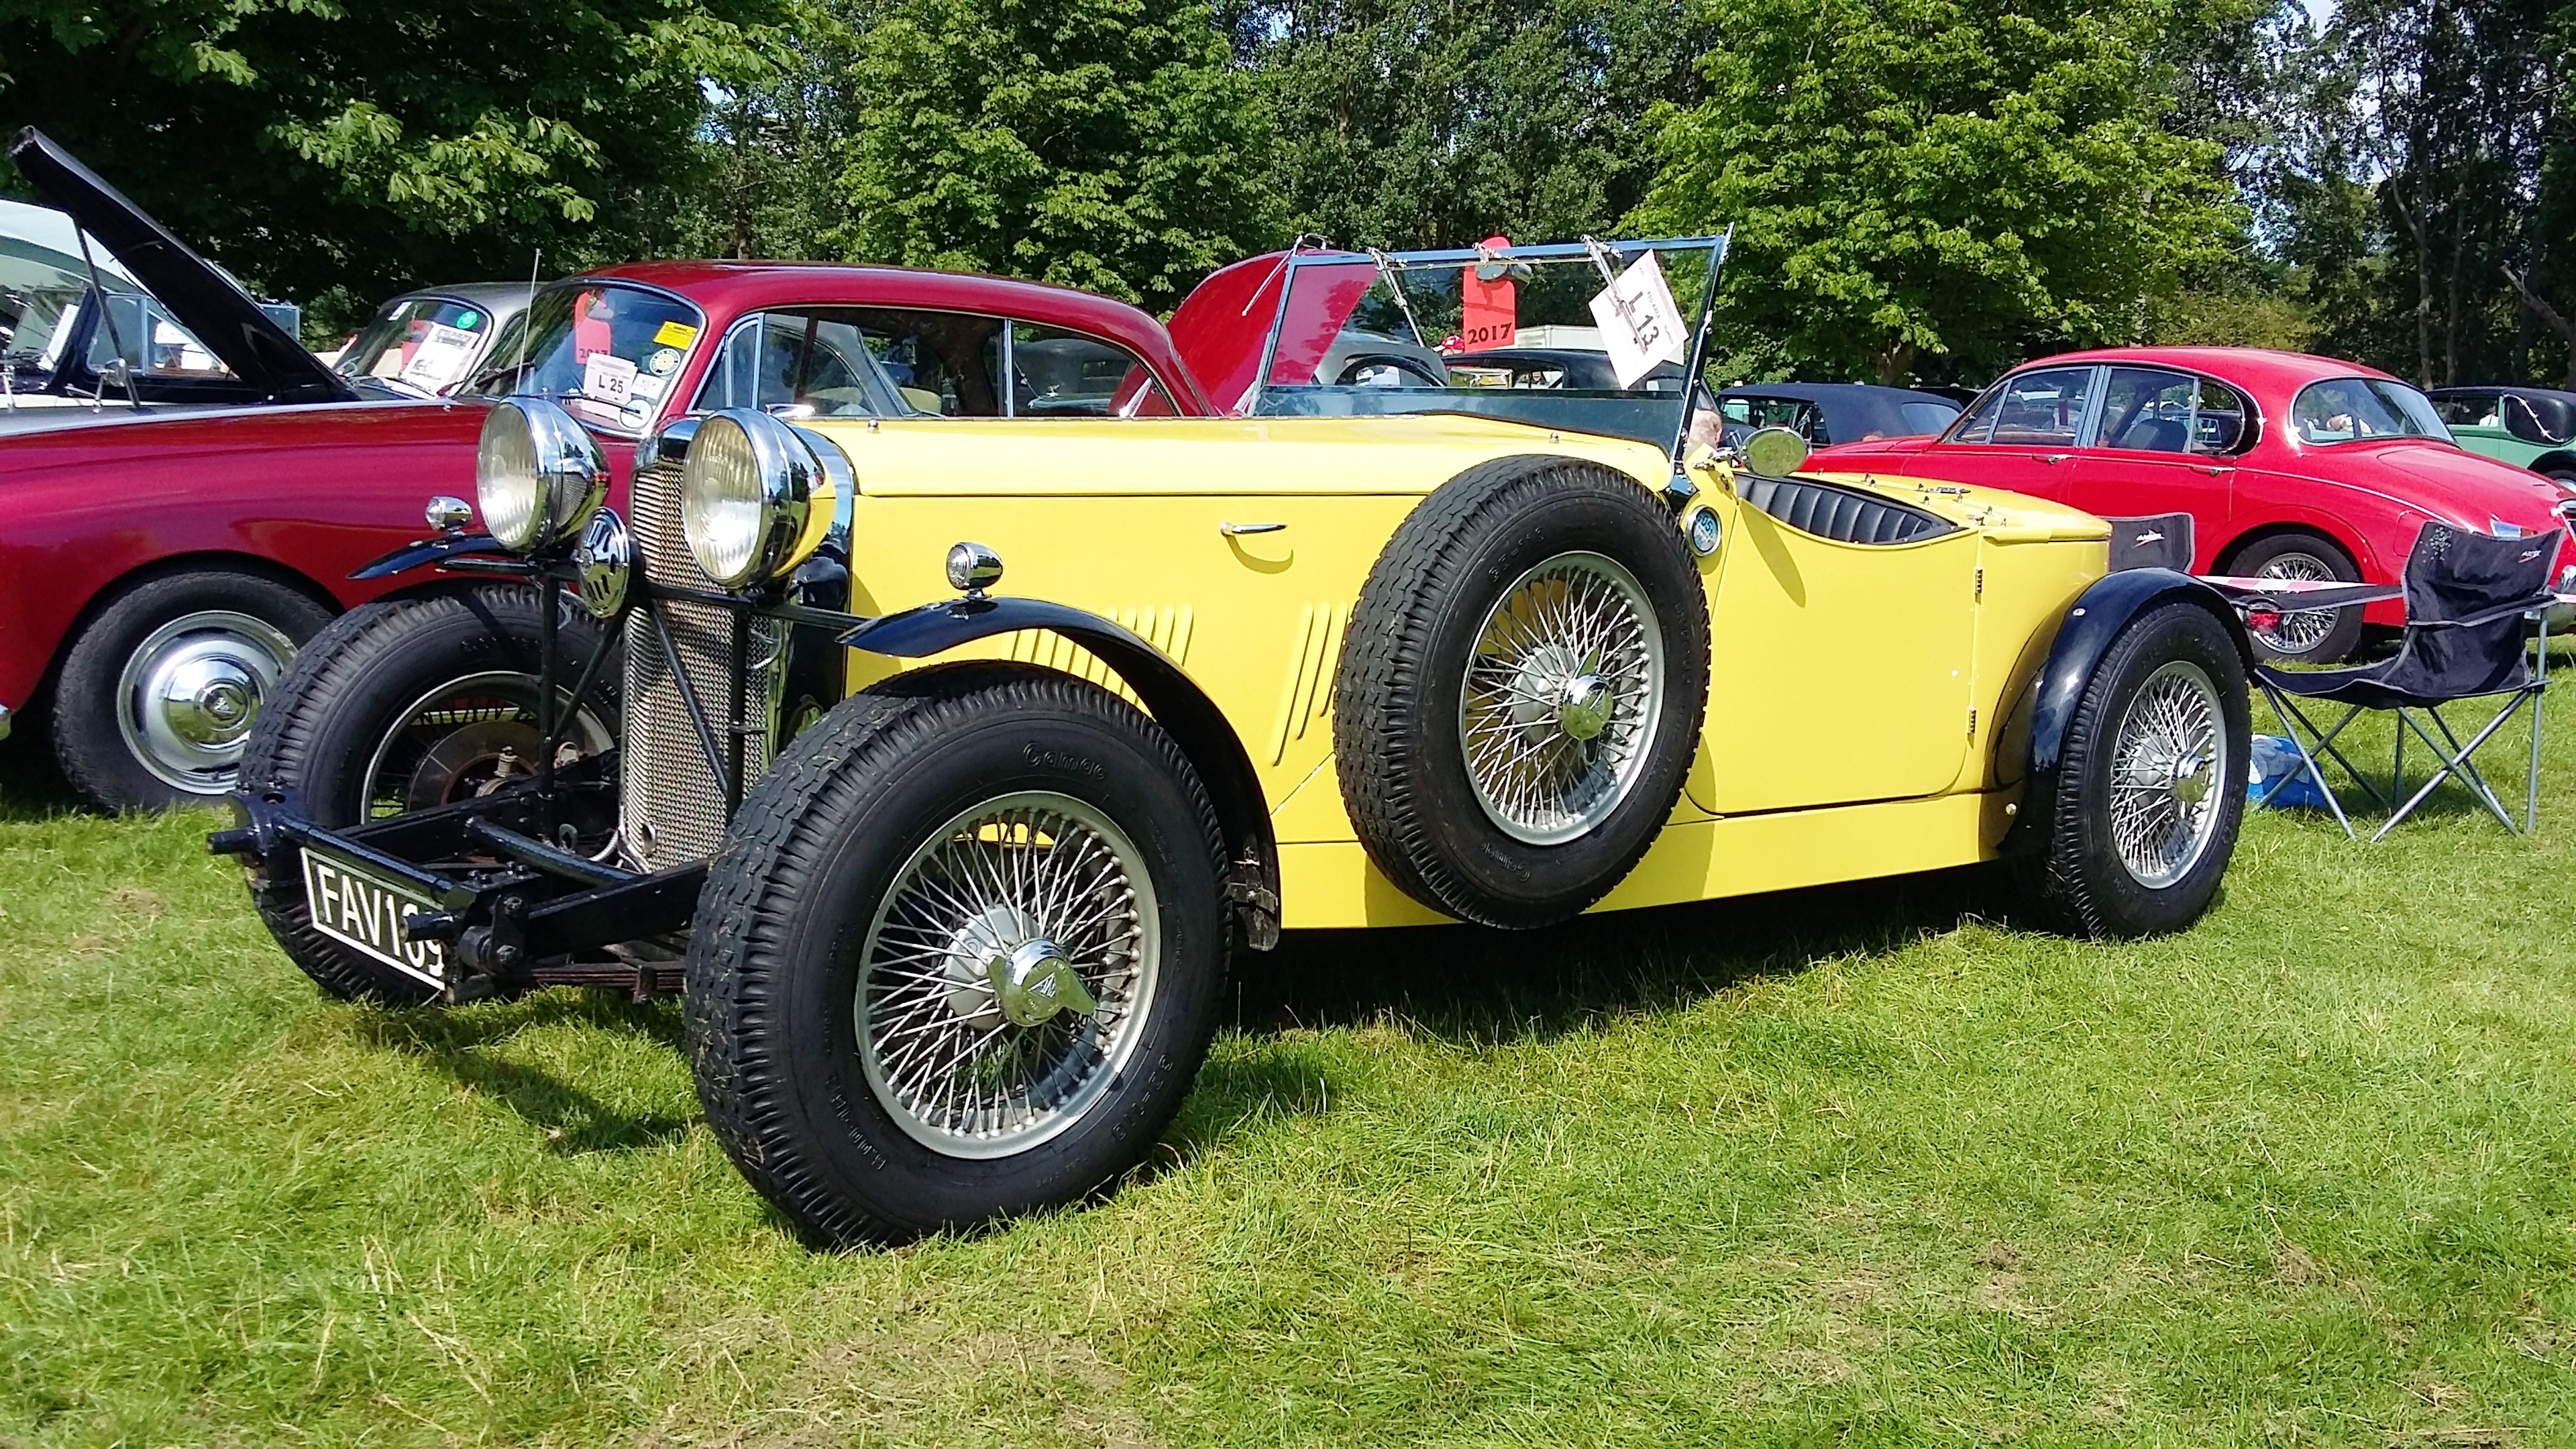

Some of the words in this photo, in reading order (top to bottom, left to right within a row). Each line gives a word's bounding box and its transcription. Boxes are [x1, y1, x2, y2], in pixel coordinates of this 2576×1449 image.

[1468, 322, 1513, 344] 2017
[1628, 290, 1644, 314] L
[1636, 314, 1660, 346] 13
[598, 374, 605, 389] L
[609, 378, 624, 394] 25
[1023, 742, 1105, 780] Camac
